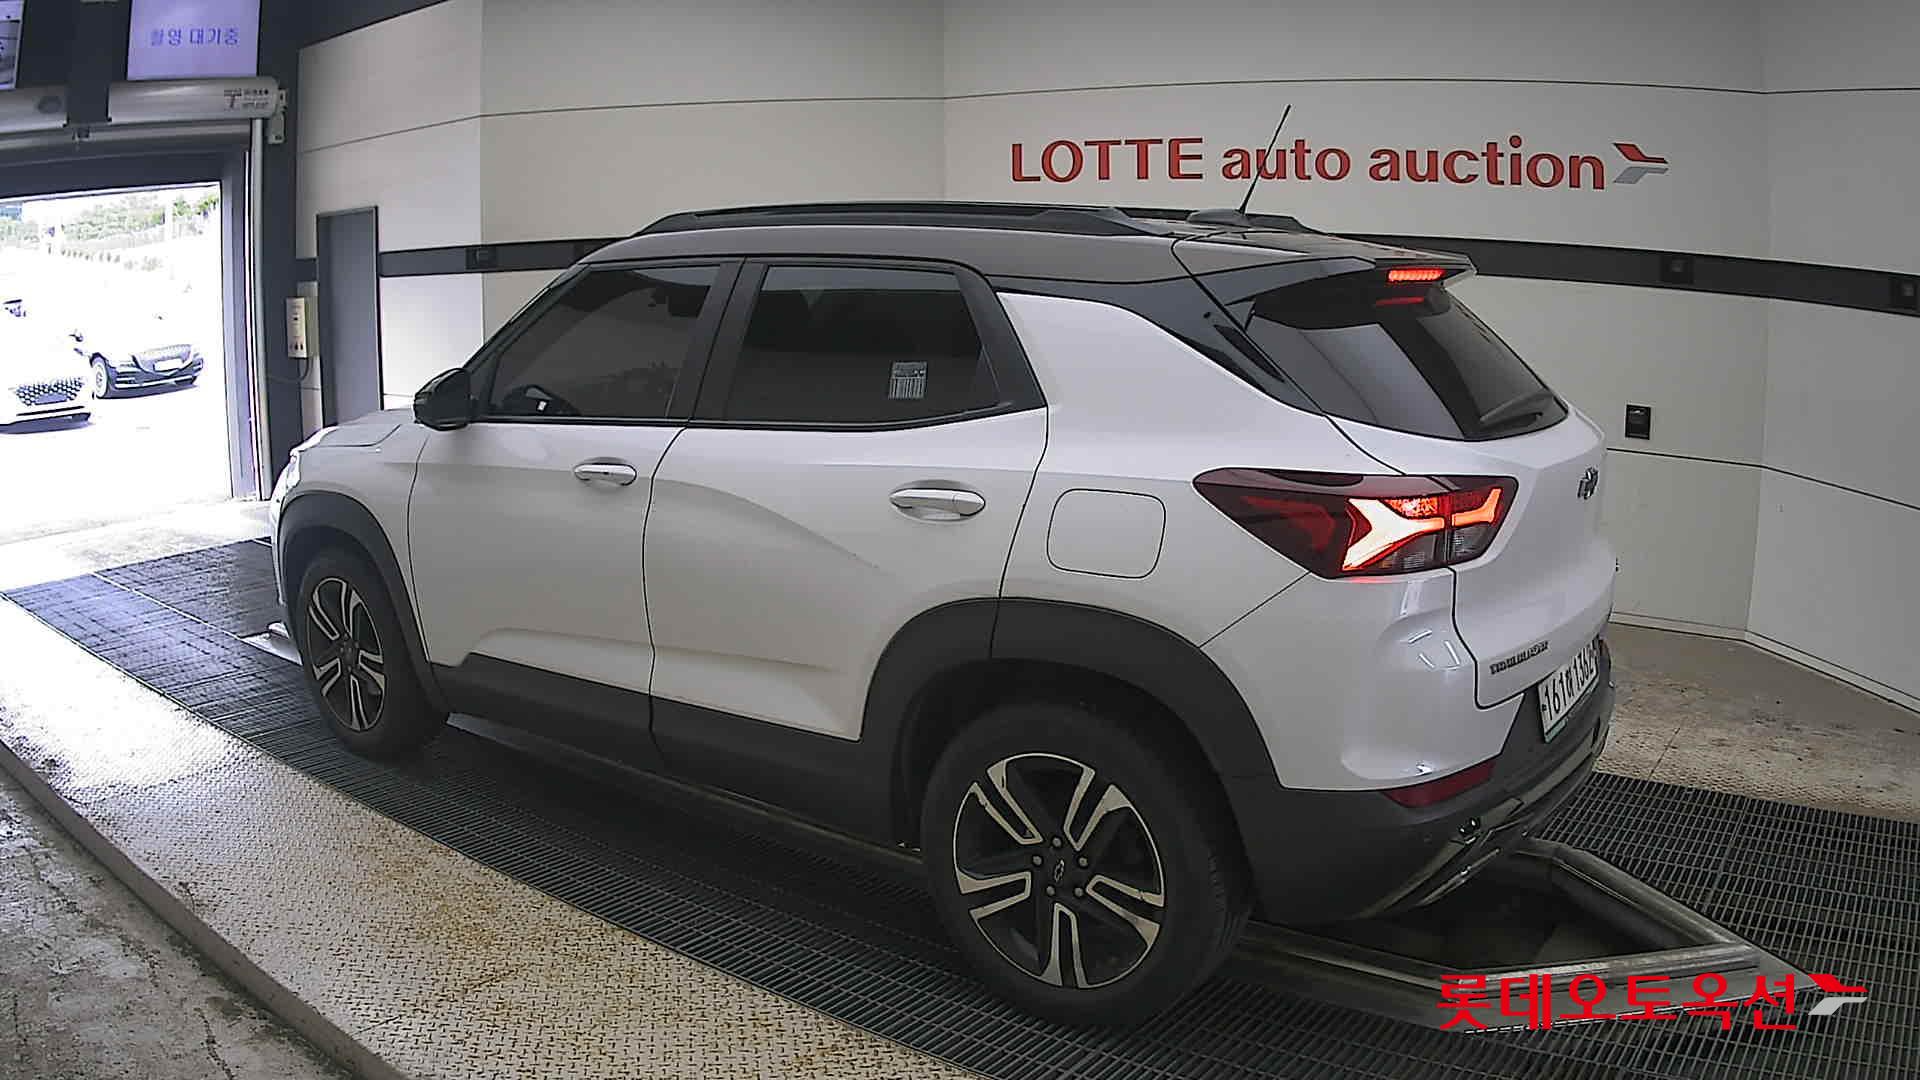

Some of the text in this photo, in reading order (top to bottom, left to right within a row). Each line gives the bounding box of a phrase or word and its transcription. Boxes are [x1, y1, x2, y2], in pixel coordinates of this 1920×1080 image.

[189, 27, 239, 46] 대기중
[1011, 135, 1606, 191] LOTTE auto auction
